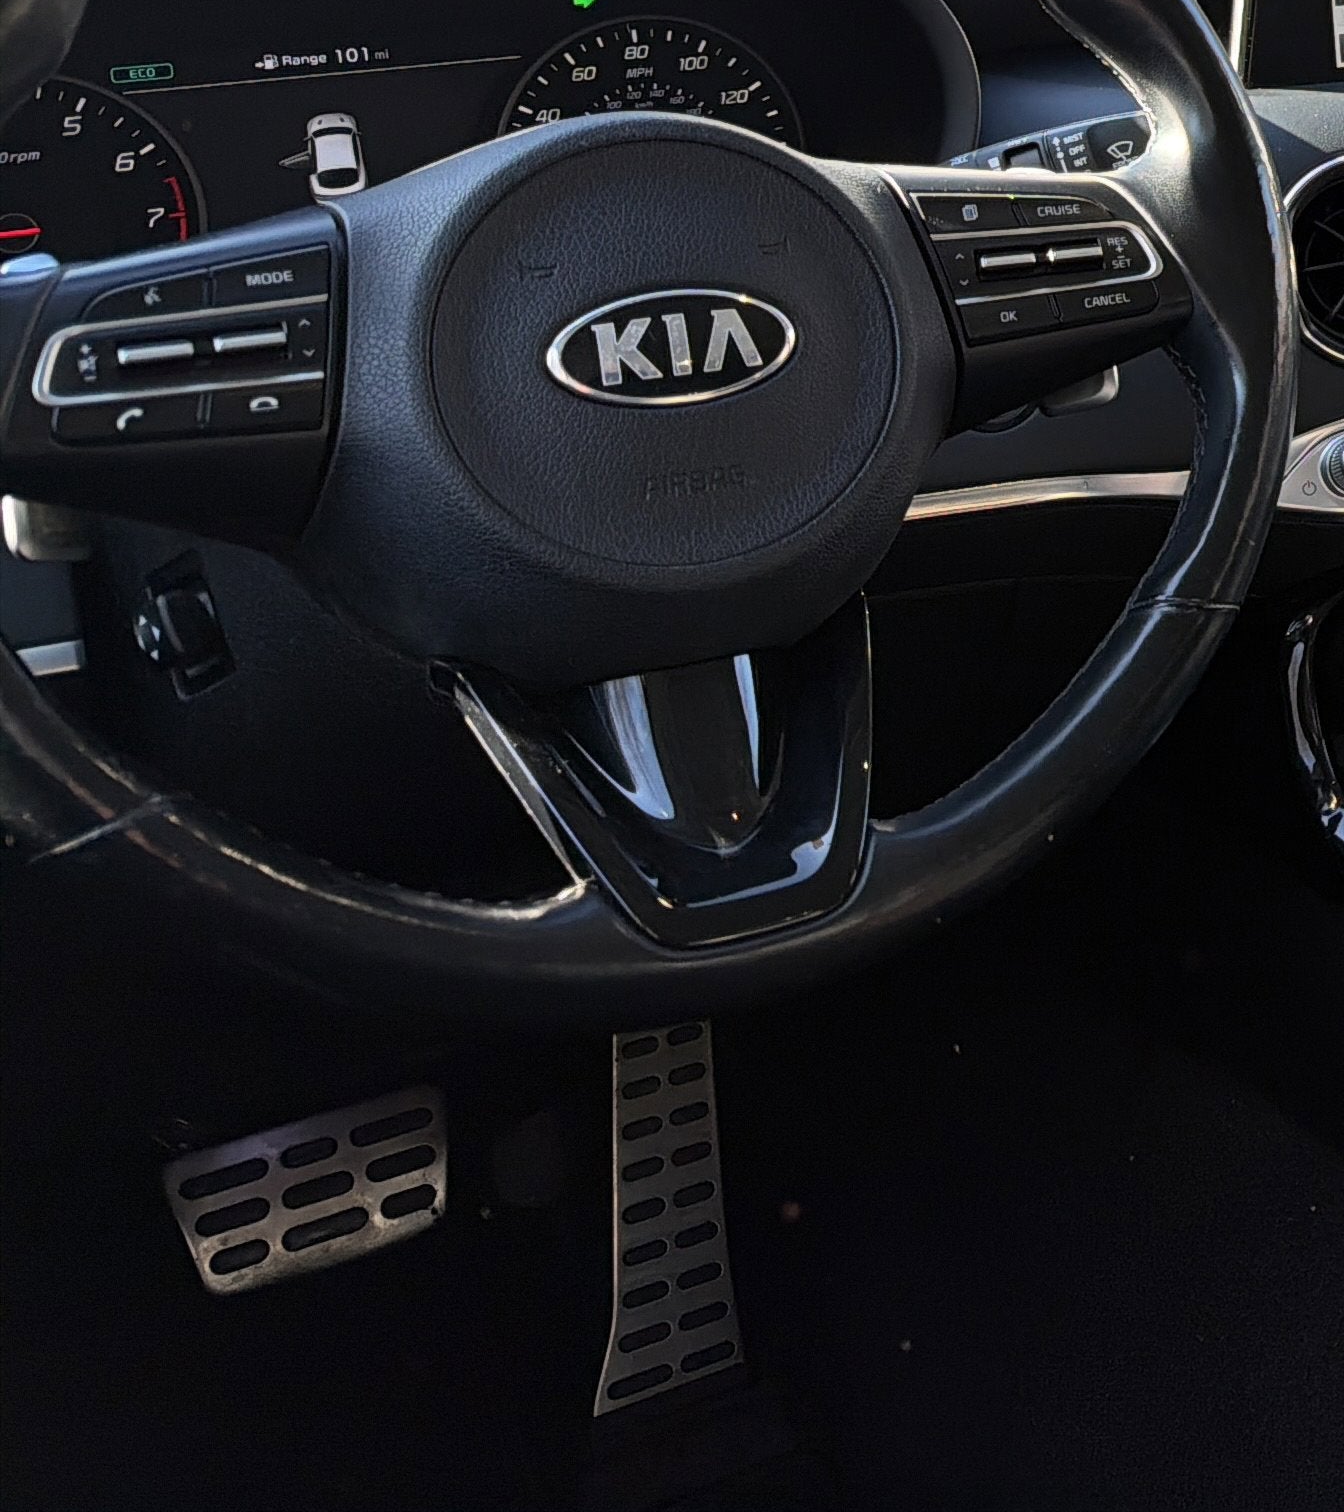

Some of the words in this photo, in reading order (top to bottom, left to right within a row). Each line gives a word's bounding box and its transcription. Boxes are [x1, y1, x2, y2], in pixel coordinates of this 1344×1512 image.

[282, 52, 327, 67] Range
[334, 47, 370, 64] 101
[374, 48, 390, 60] mi
[624, 45, 649, 60] 80
[679, 55, 708, 71] 100
[129, 67, 156, 79] ECO
[571, 66, 596, 81] 60
[626, 67, 653, 79] MPH
[720, 89, 749, 104] 120
[535, 108, 561, 123] 40
[62, 115, 82, 136] 5
[1069, 145, 1086, 156] OFF
[115, 152, 135, 172] 6
[1073, 157, 1088, 167] INT
[147, 207, 165, 228] 7
[1037, 203, 1081, 217] CRUISE
[1107, 236, 1128, 247] RES
[1112, 259, 1131, 269] SET
[246, 270, 294, 286] MODE
[1084, 294, 1131, 309] CANCEL
[1000, 311, 1018, 323] OK
[591, 308, 763, 387] KIA
